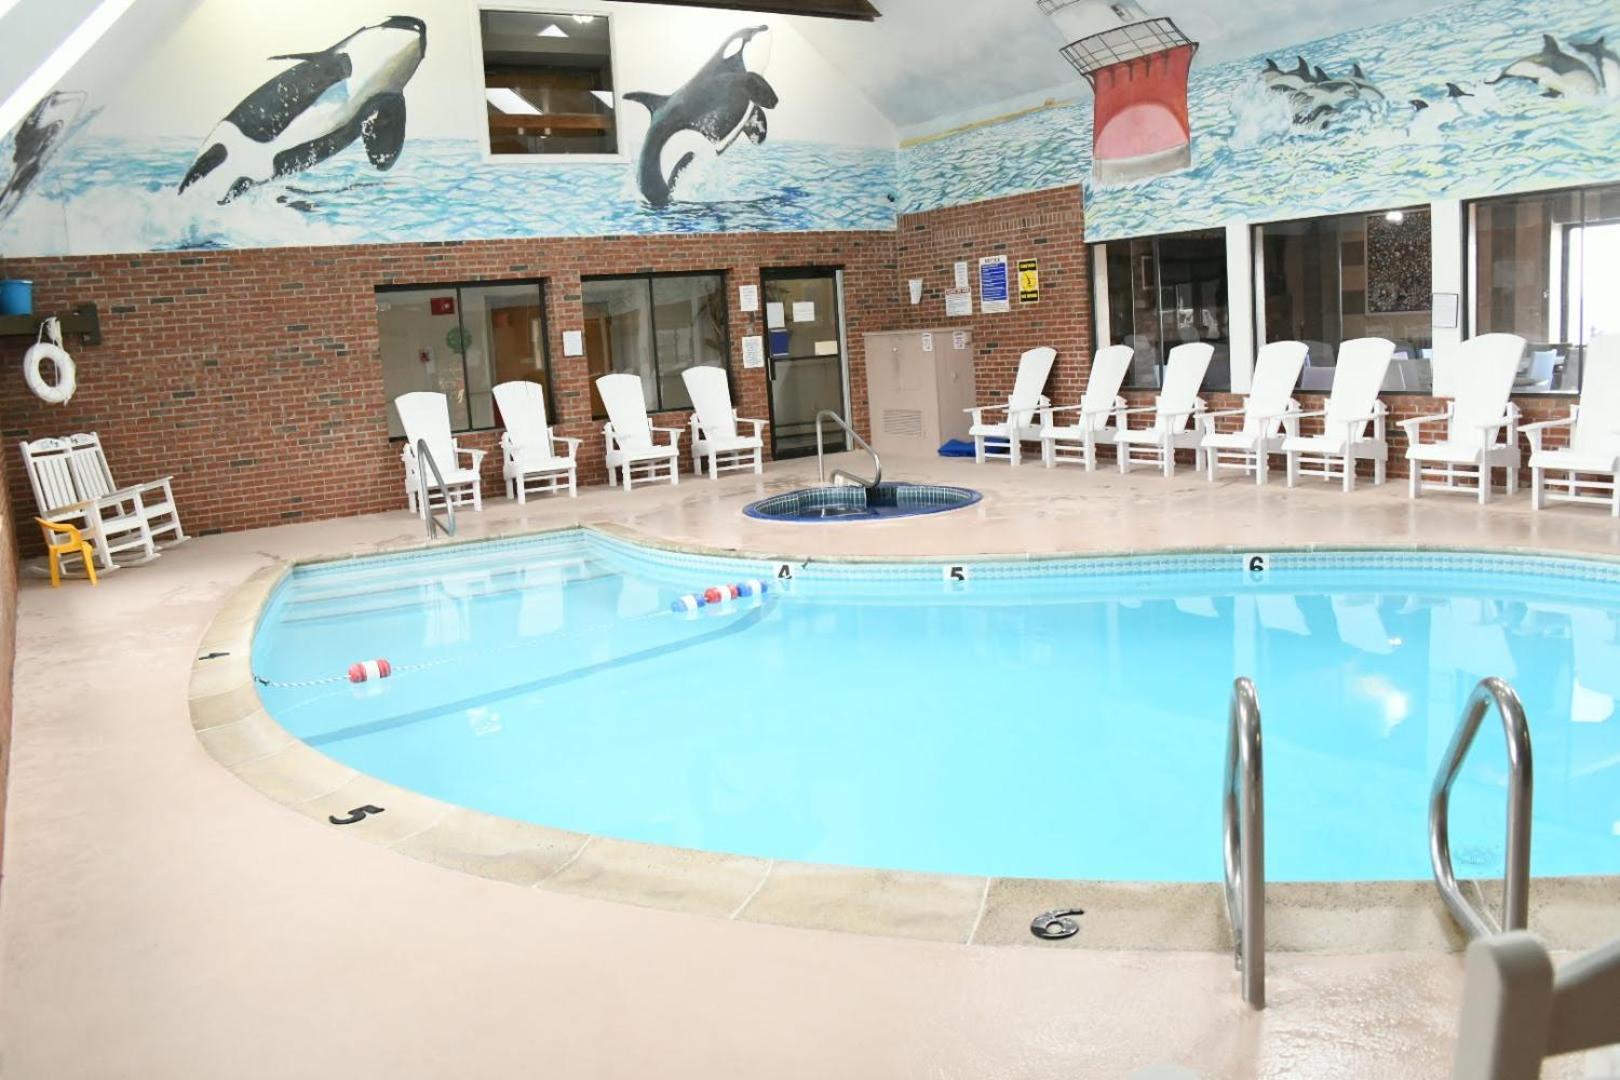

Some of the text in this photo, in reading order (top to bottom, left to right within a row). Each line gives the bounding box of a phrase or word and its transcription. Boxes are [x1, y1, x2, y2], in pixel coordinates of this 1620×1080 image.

[1248, 556, 1264, 571] 6
[777, 564, 792, 579] 4
[950, 566, 965, 580] 5
[328, 804, 385, 825] 5
[1030, 908, 1085, 940] 6
